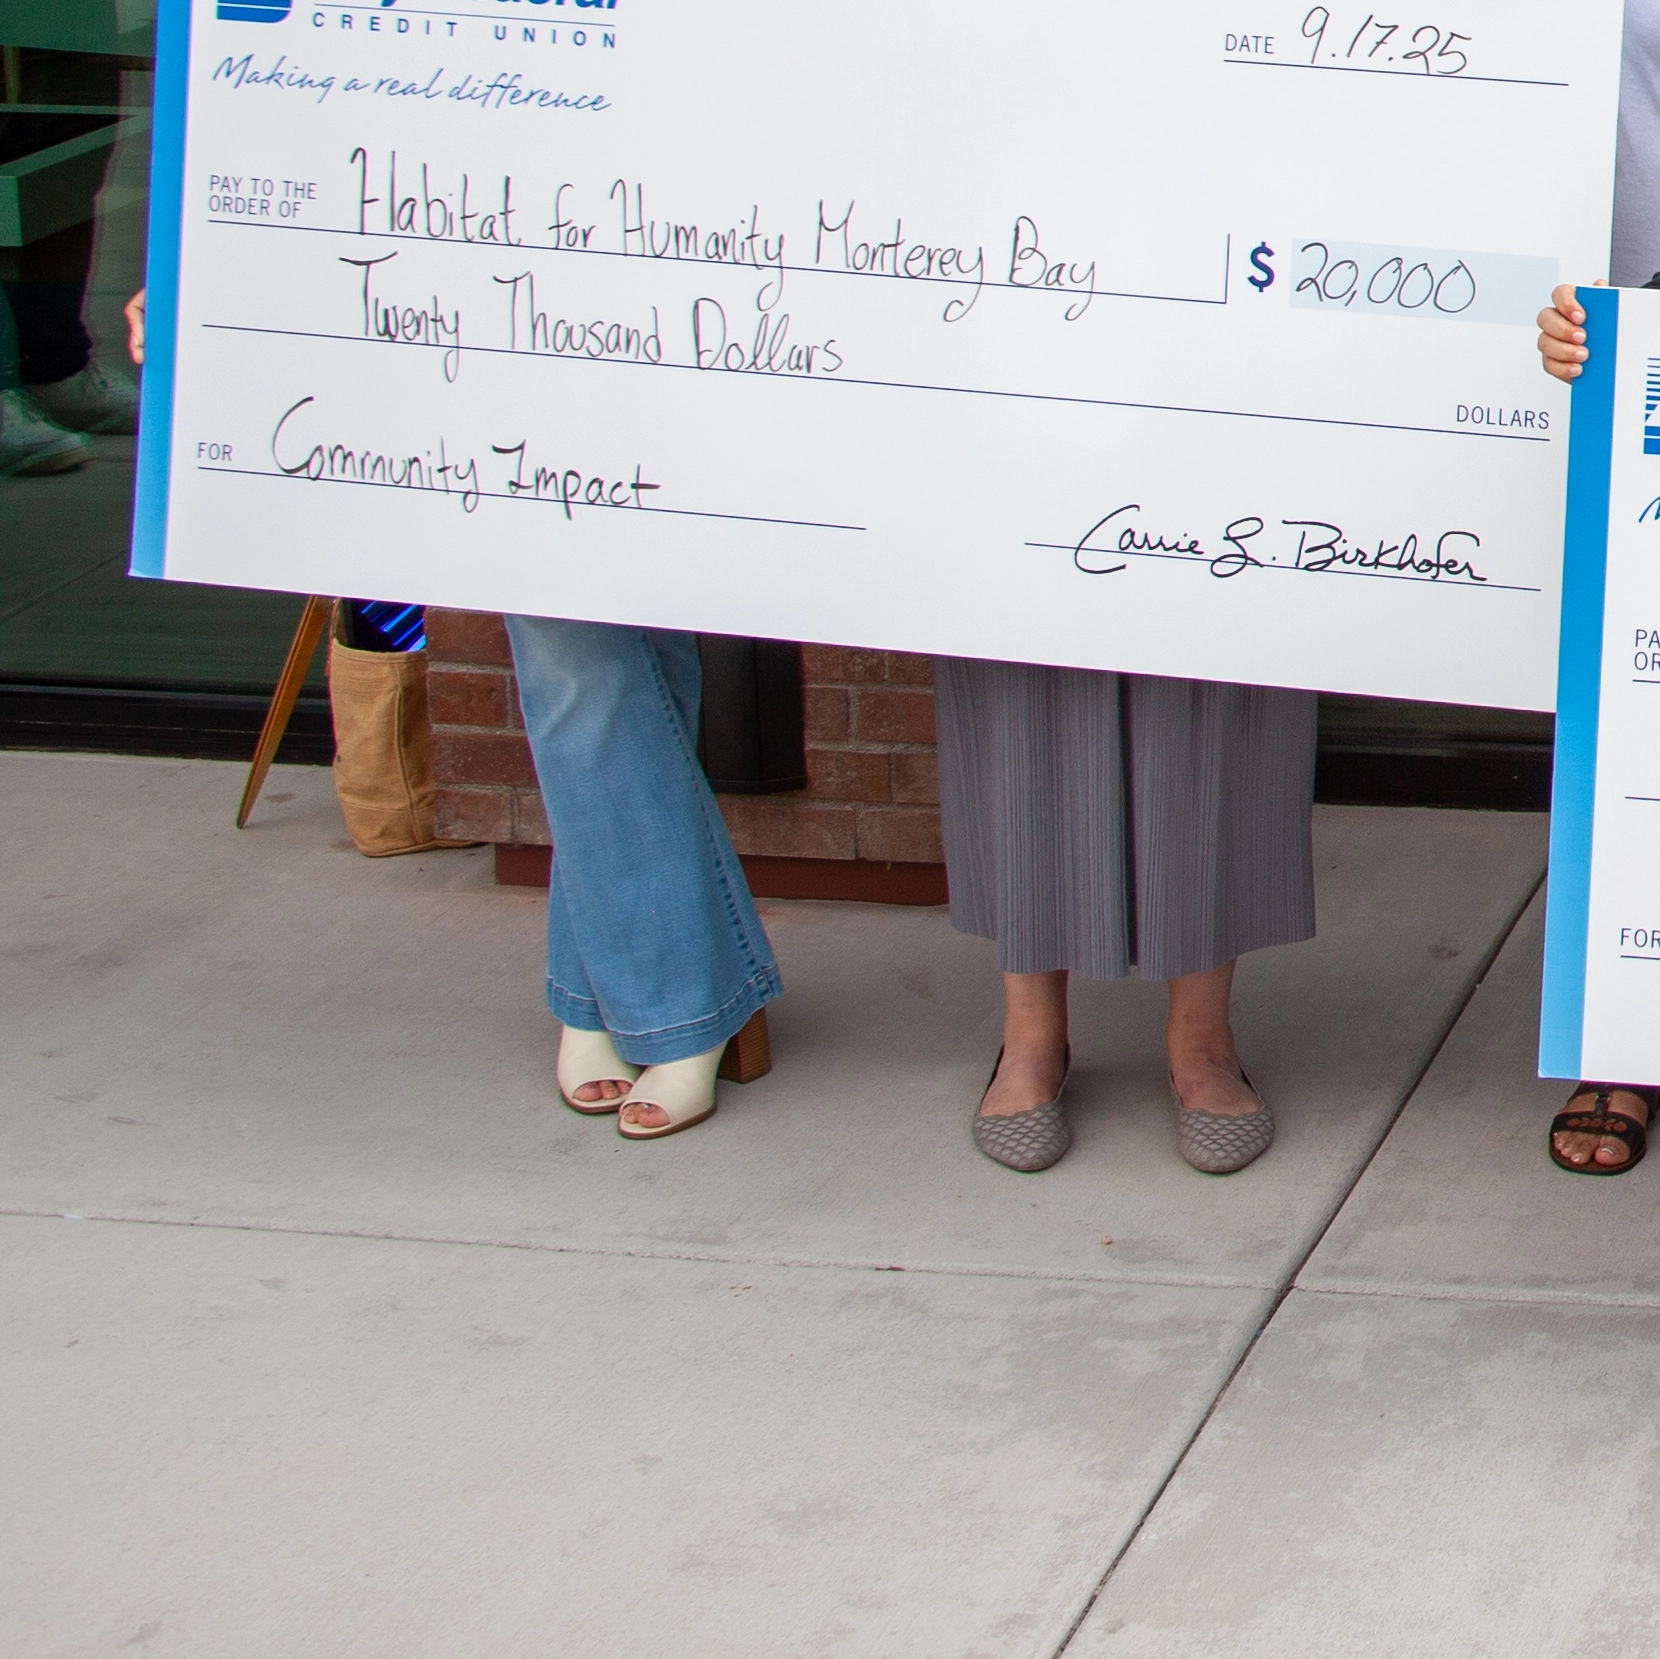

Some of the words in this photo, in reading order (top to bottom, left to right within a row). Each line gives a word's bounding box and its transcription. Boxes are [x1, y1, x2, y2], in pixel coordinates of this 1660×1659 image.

[313, 13, 458, 37] CREDIT
[495, 25, 615, 48] UNION
[1225, 34, 1274, 55] DATE
[1301, 6, 1472, 76] 9.17.25
[212, 54, 335, 103] Making
[344, 77, 370, 92] a
[374, 68, 444, 99] real
[447, 72, 611, 113] difference
[210, 175, 242, 193] PAY
[251, 178, 274, 196] TO
[283, 181, 316, 200] THE
[210, 195, 270, 216] ORDER
[280, 200, 301, 218] OF
[350, 147, 521, 247] Habitat
[548, 183, 596, 249] for
[610, 178, 784, 311] Humanity
[816, 200, 983, 321] Monterey
[1008, 216, 1096, 321] Bay
[1295, 243, 1476, 313] 20,000
[339, 251, 460, 382] Twenty
[493, 271, 661, 363] Thousand
[693, 297, 843, 374] Dollars
[1456, 405, 1549, 430] DOLLARS
[197, 443, 232, 461] FOR
[273, 396, 477, 512] Community
[492, 440, 660, 520] Impact
